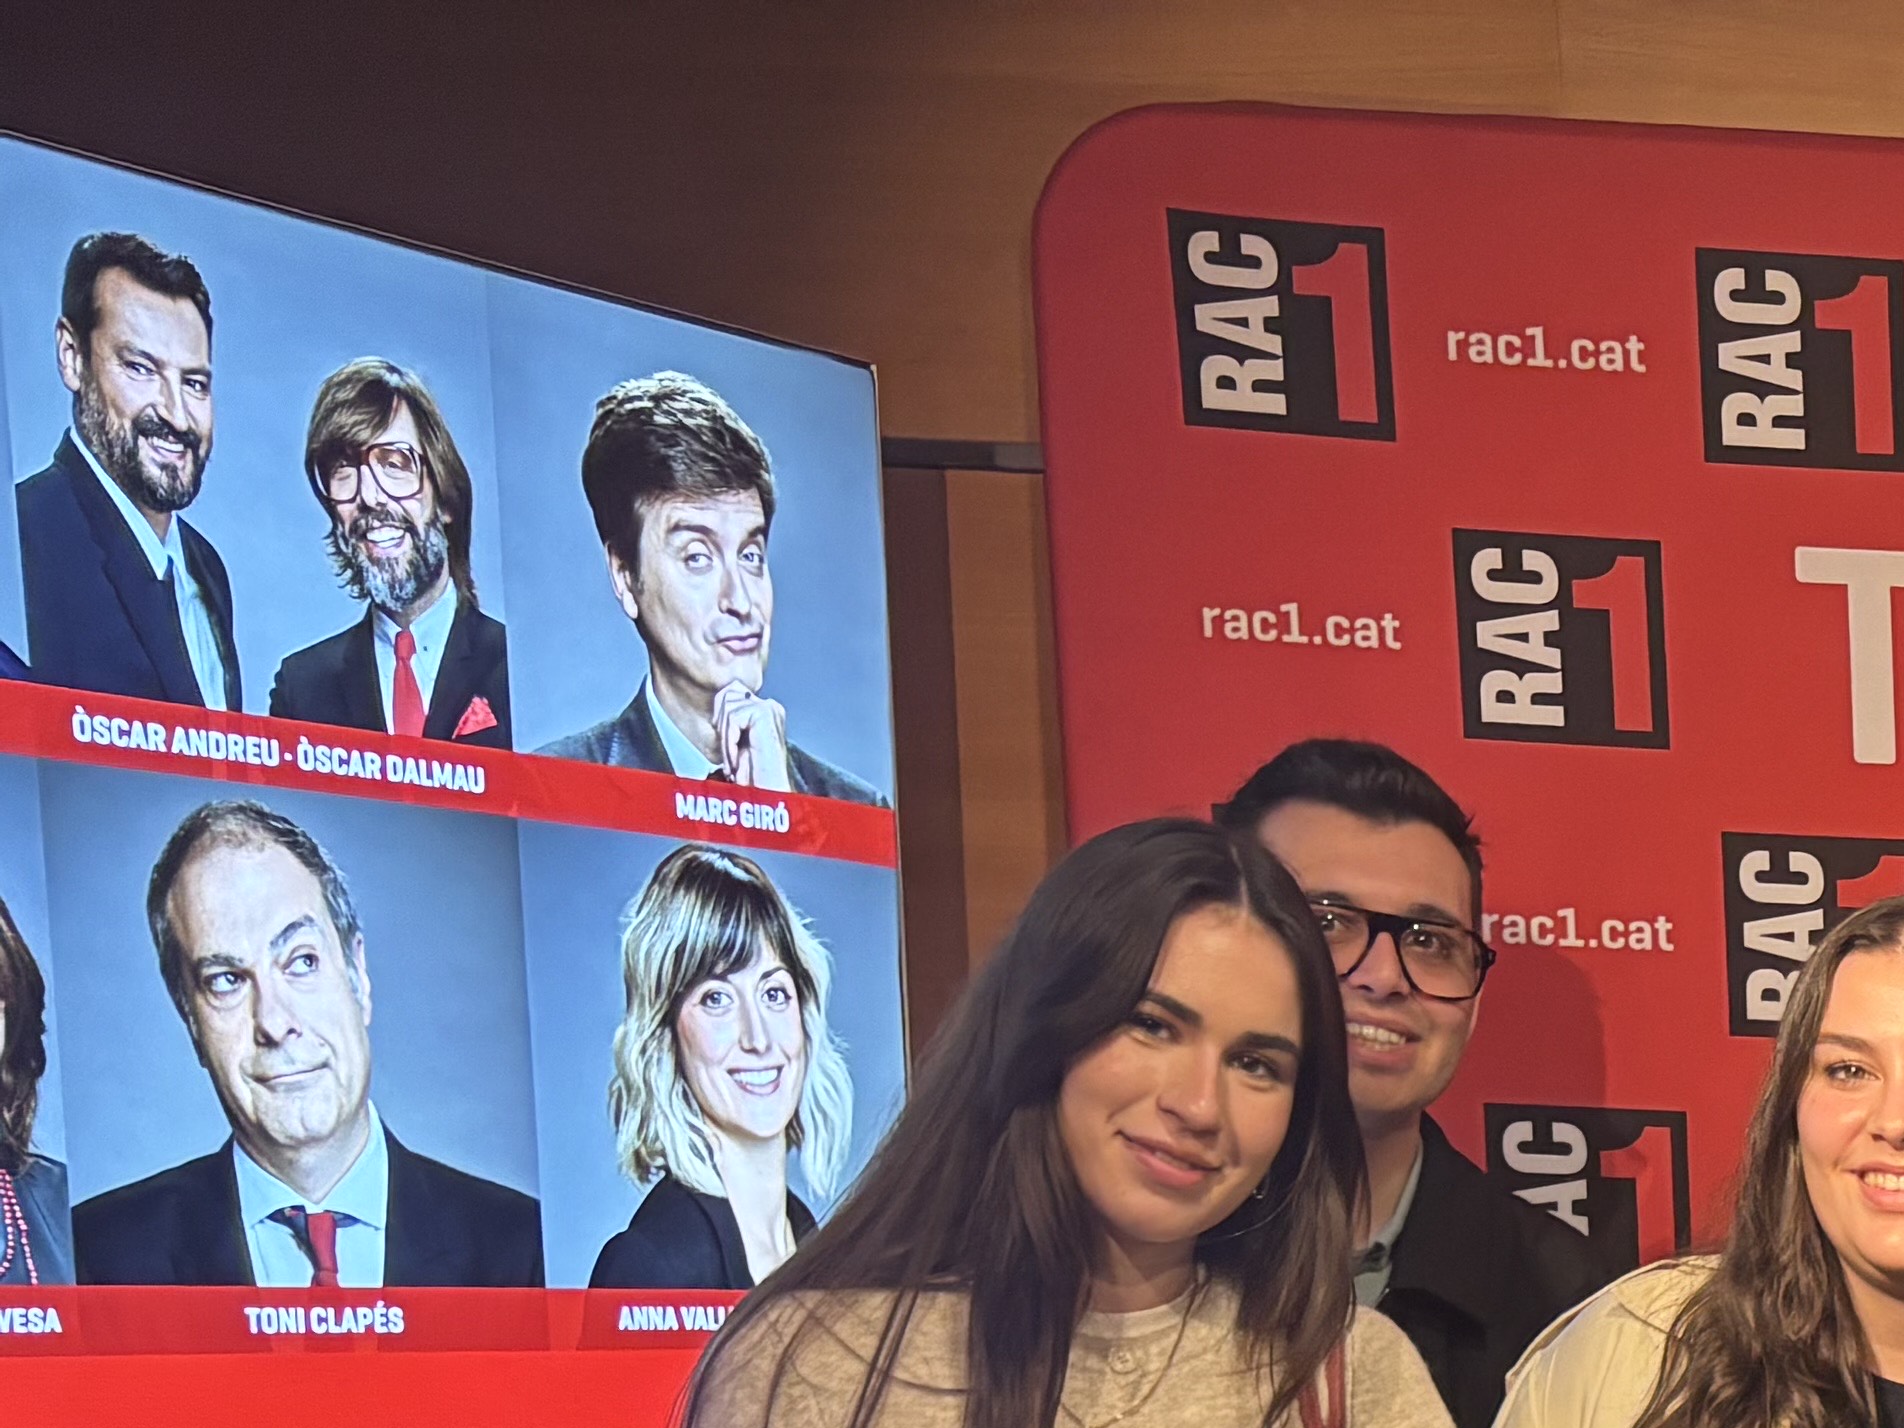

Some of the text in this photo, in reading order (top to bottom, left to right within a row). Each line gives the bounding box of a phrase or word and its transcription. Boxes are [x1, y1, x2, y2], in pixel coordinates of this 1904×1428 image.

[1188, 231, 1378, 423] RAC 1
[1448, 327, 1646, 372] rac1.cat
[1714, 268, 1894, 455] RAC 1
[1203, 603, 1401, 649] rac1.cat
[1471, 548, 1653, 732] RAC 1
[72, 706, 167, 752] ÒSCAR
[172, 727, 279, 766] ANDREU
[297, 736, 381, 779] ÒSCAR
[386, 755, 485, 793] DALMAU
[676, 793, 789, 833] MARC GIRÓ
[1482, 908, 1674, 951] rac1.cat
[1502, 1121, 1589, 1237] AC
[244, 1301, 404, 1334] TONI CLAPÉS
[619, 1306, 678, 1330] ANNA
